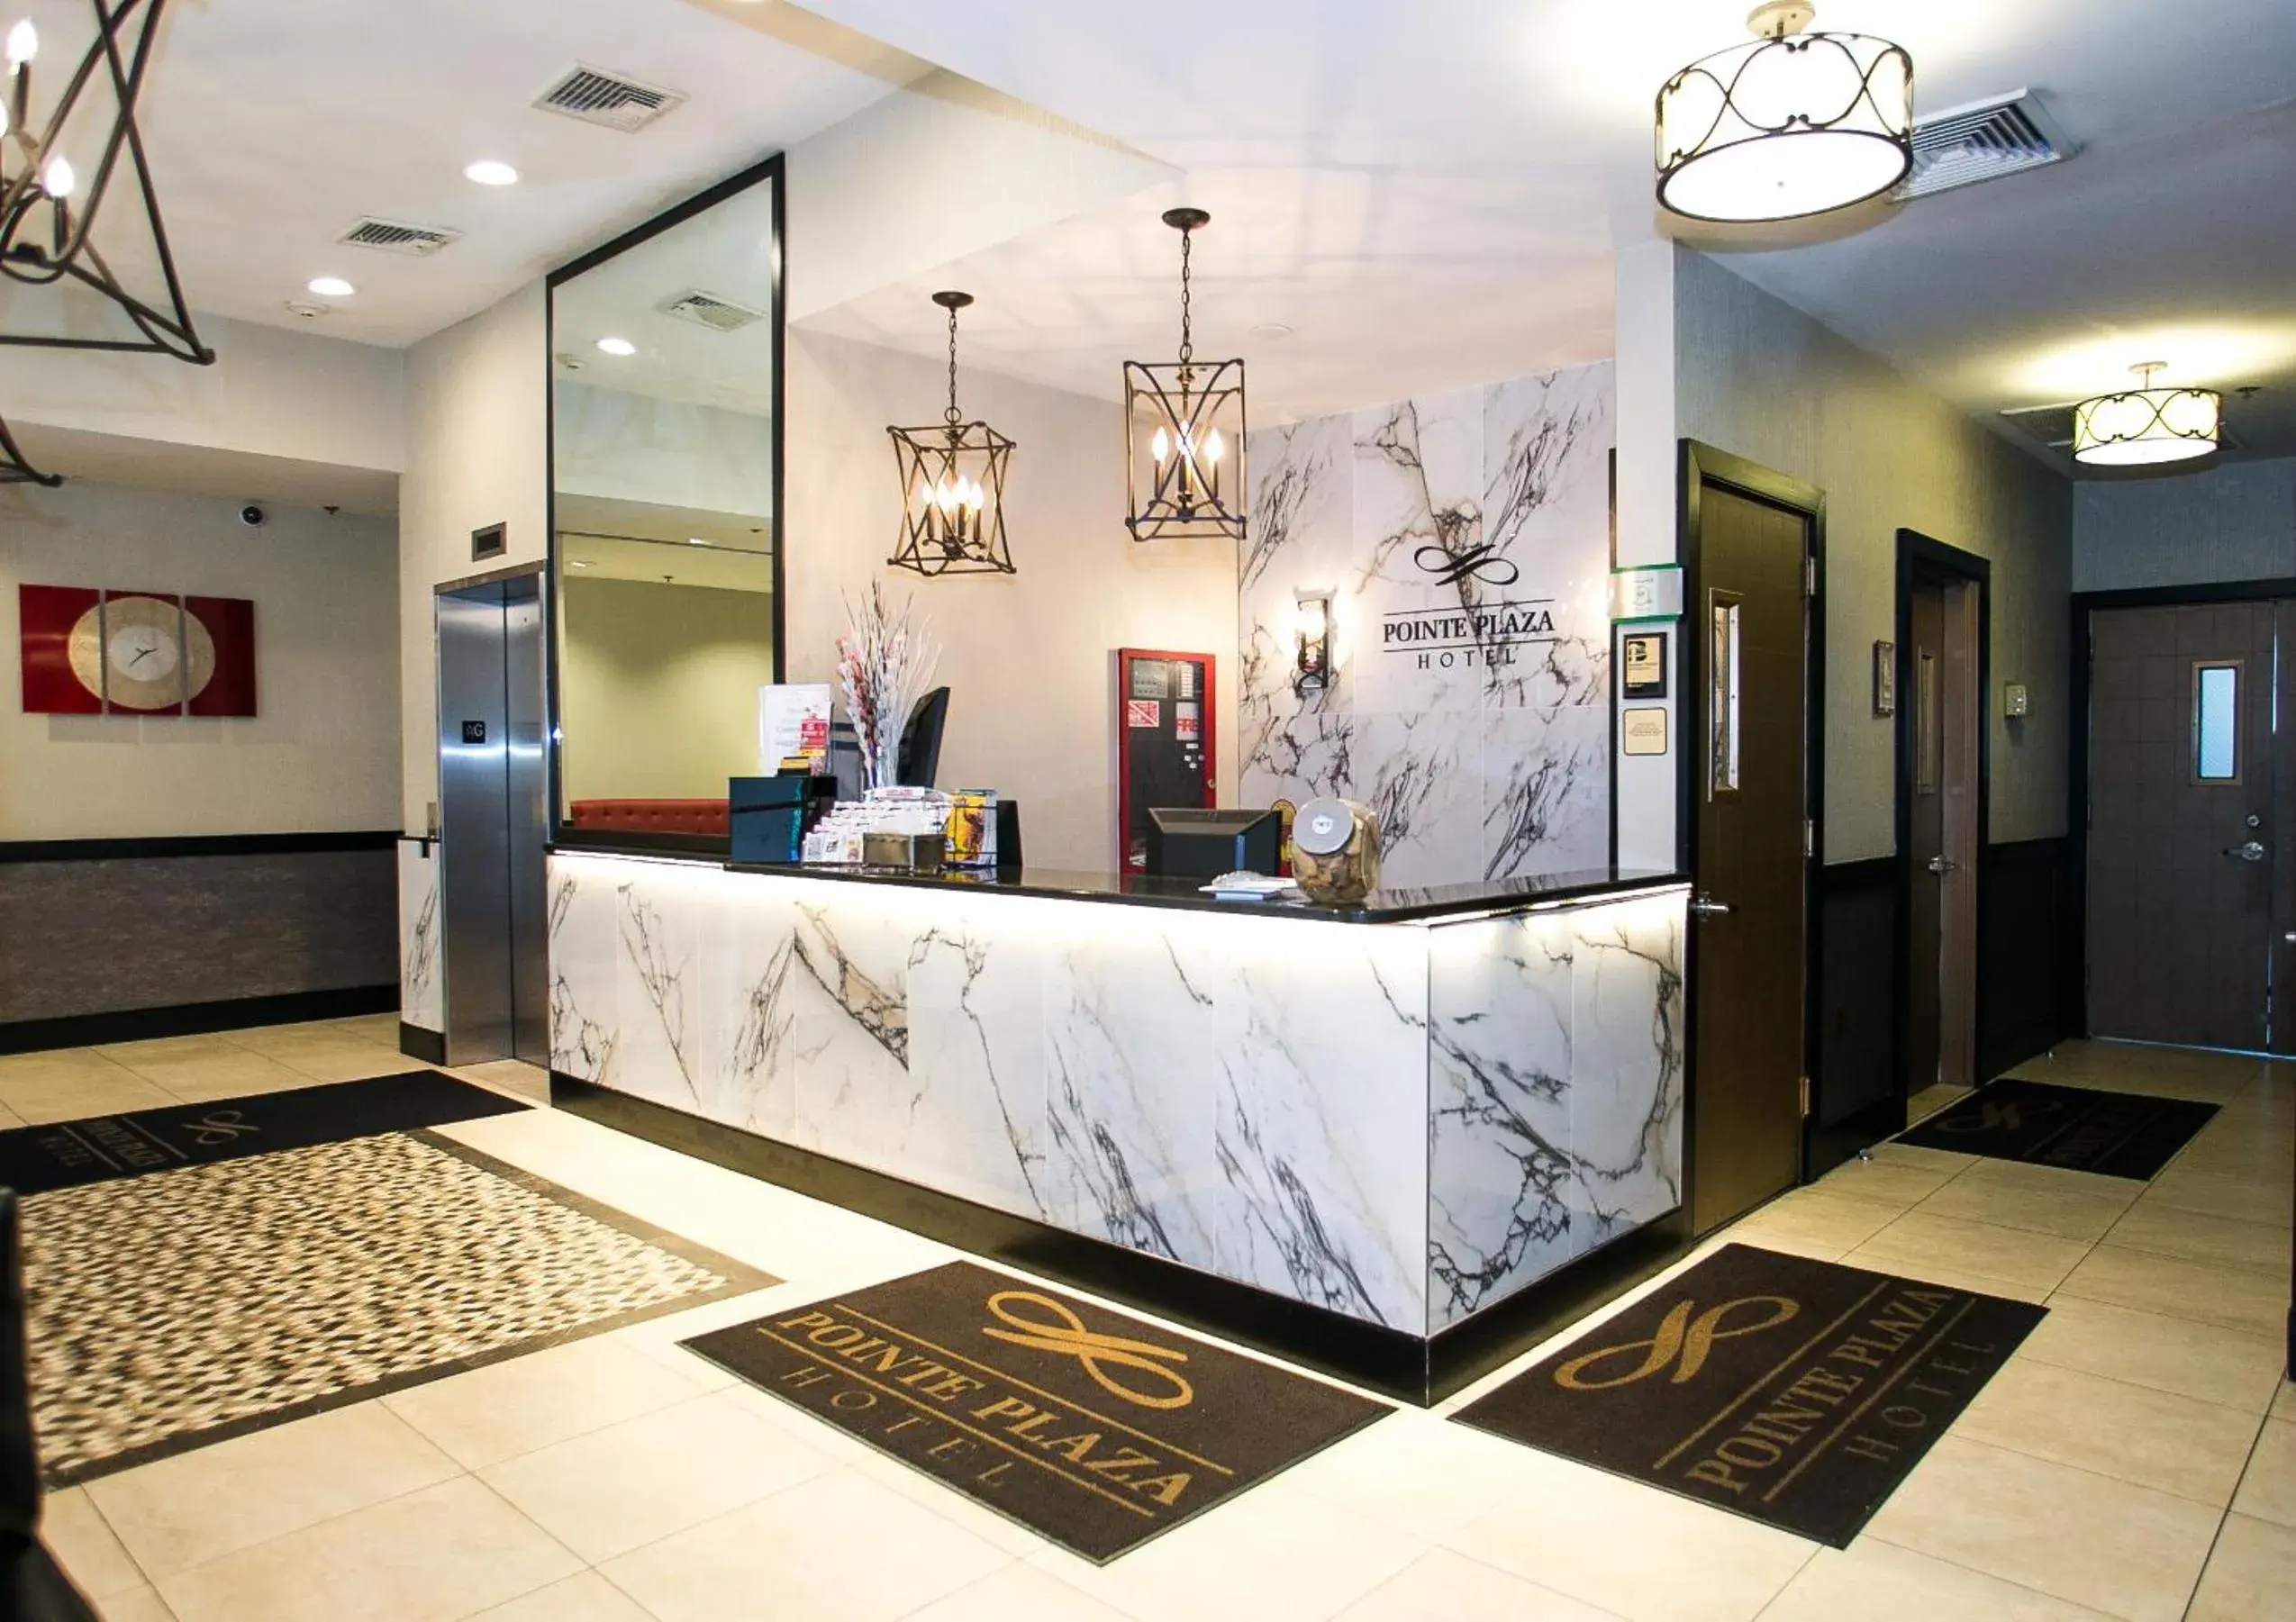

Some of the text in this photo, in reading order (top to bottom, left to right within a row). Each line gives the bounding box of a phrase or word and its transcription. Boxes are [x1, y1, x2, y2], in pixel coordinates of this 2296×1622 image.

[1384, 611, 1555, 642] POINTE PLAZA
[1418, 648, 1516, 670] HOTEL
[776, 1311, 1193, 1506] POINTE PLAZA
[780, 1367, 1013, 1487] HOTEL
[1684, 1290, 1954, 1495] POINTE PLAZA
[1843, 1341, 1997, 1463] HOTEL
